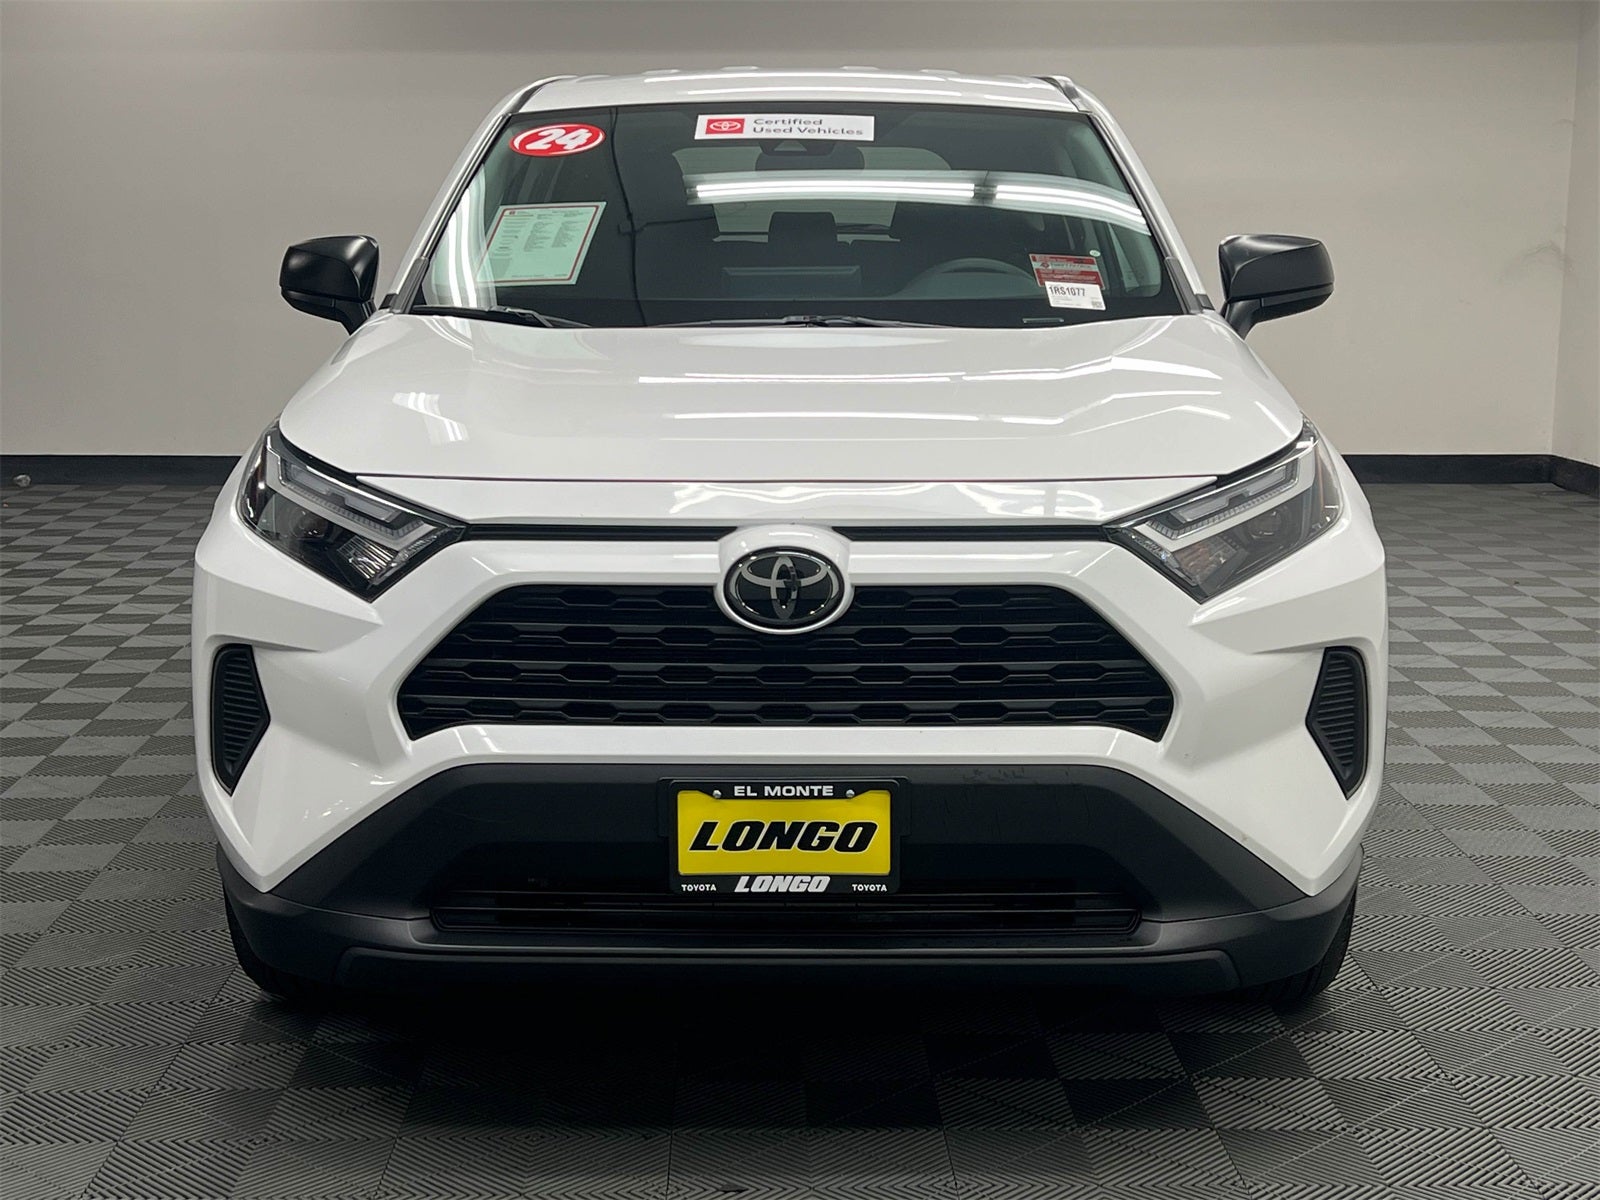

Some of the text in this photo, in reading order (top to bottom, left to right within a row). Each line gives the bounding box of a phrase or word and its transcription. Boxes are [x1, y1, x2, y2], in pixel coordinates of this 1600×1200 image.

[753, 118, 823, 126] Certified
[753, 126, 863, 136] Used Vehicles
[525, 128, 592, 150] 24
[1049, 286, 1086, 297] 1RS1077
[734, 785, 834, 797] EL MONTE
[688, 820, 879, 853] LONGO
[681, 883, 717, 892] TOYOTA
[734, 875, 831, 893] LONGO
[851, 883, 888, 892] TOYOTA
